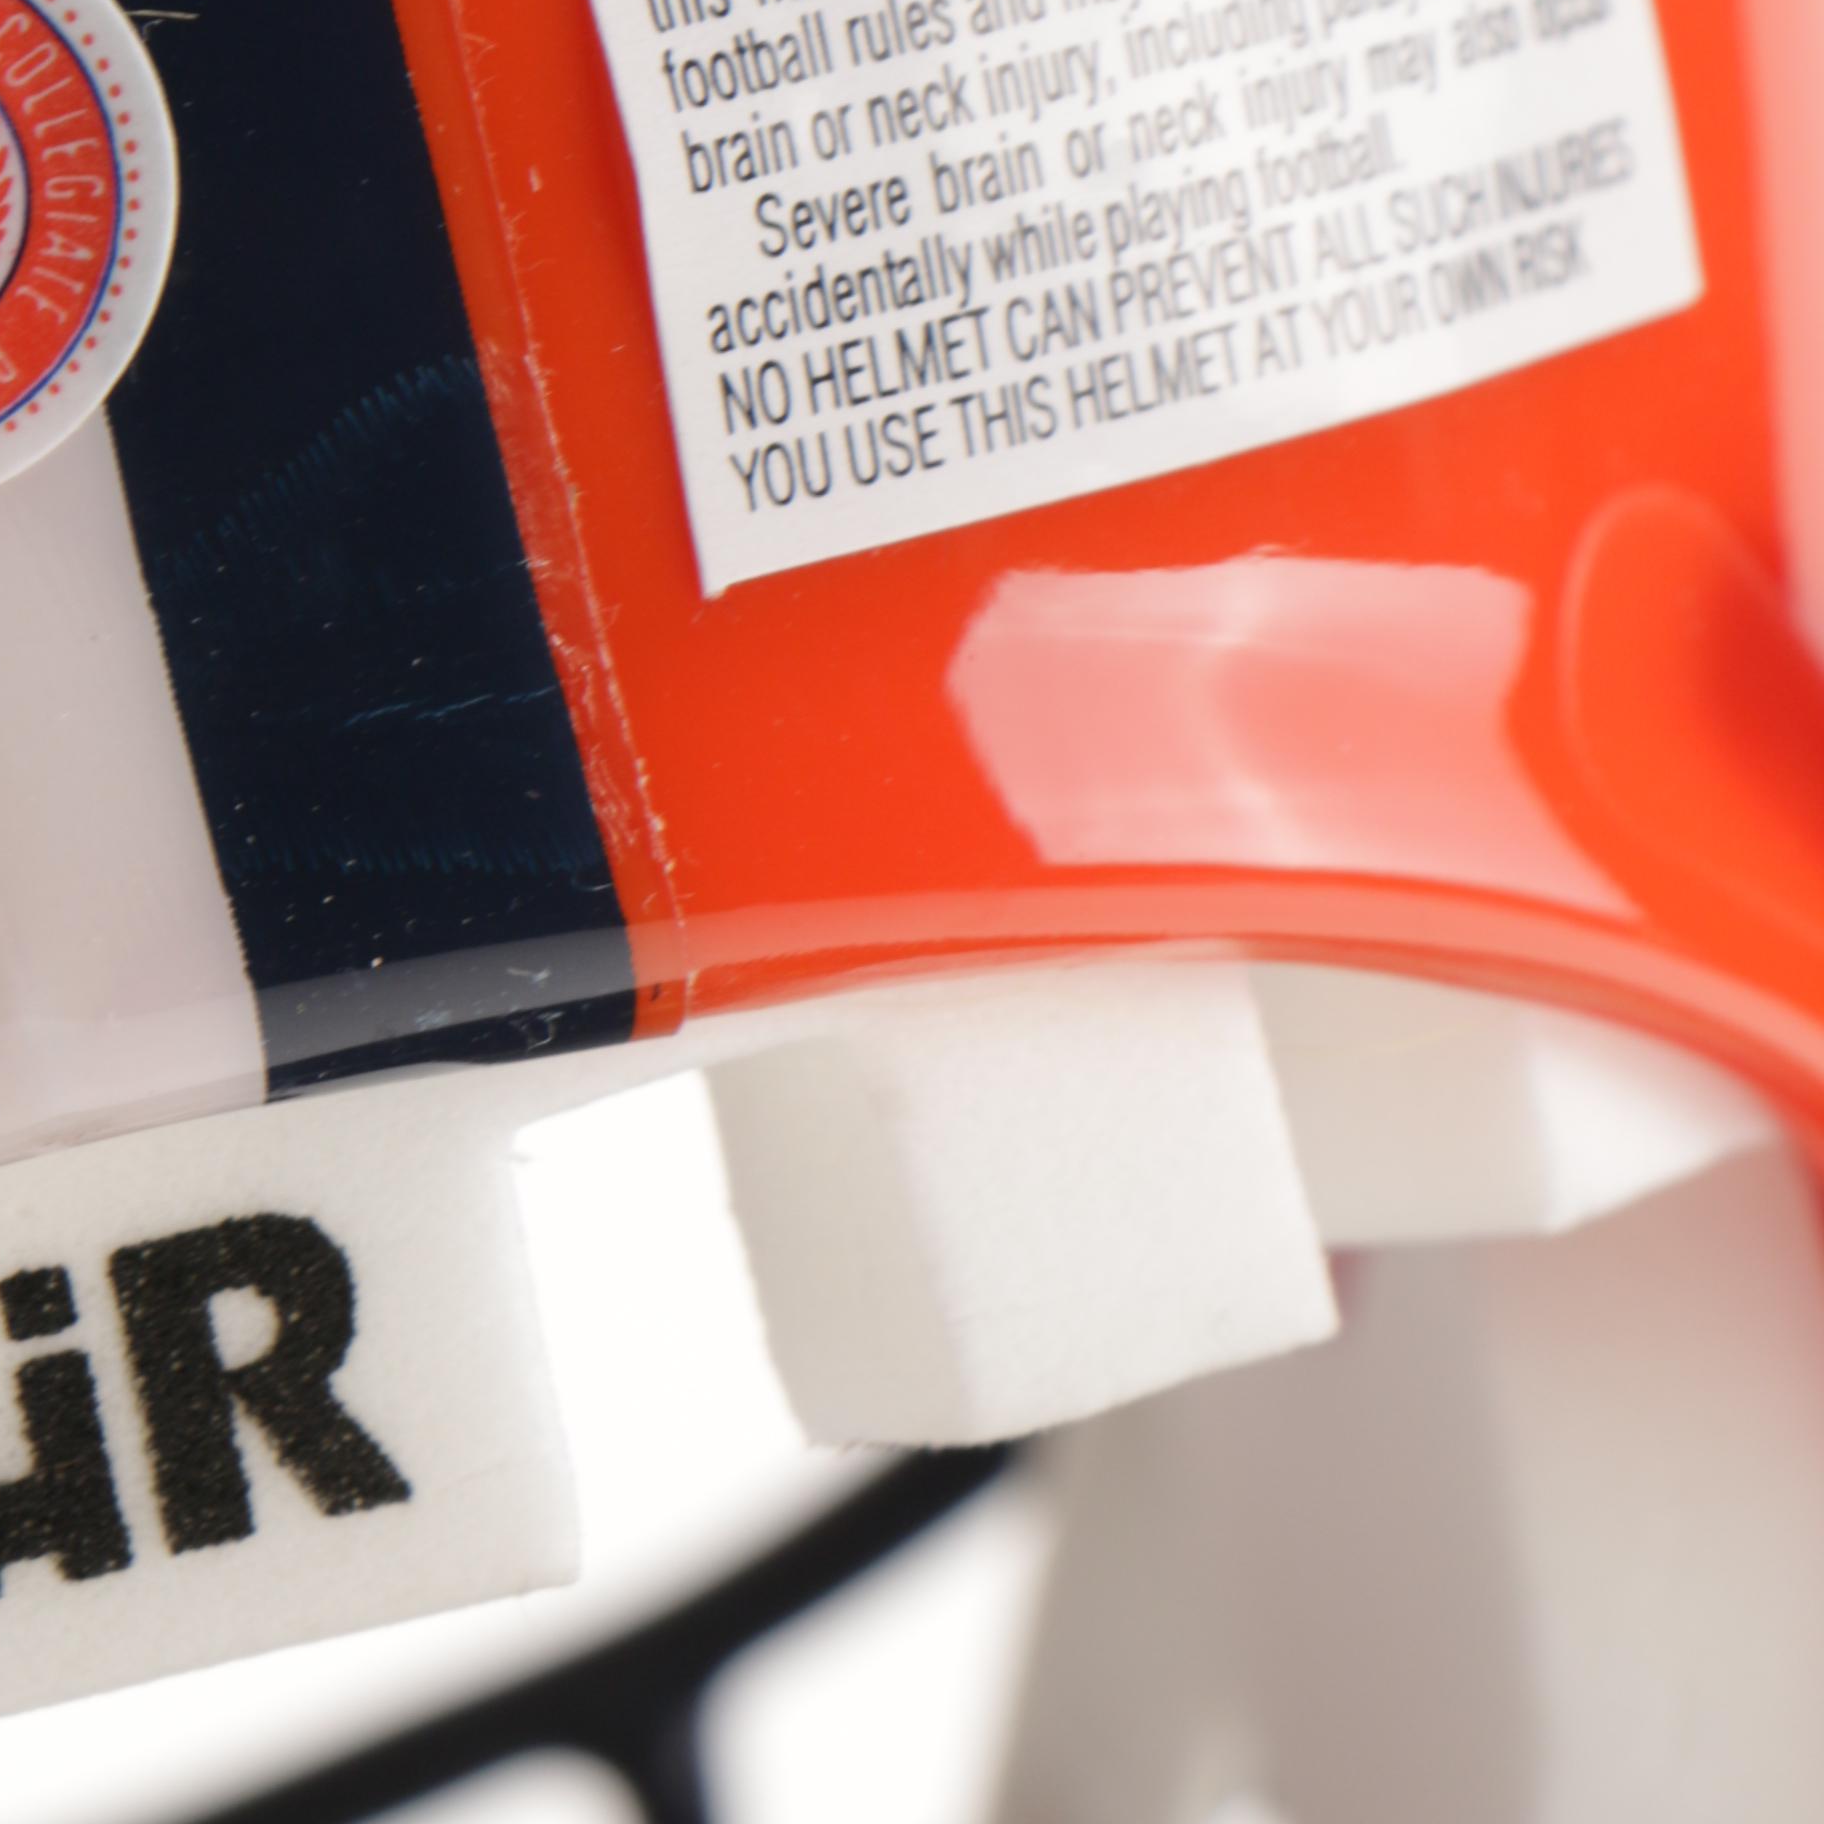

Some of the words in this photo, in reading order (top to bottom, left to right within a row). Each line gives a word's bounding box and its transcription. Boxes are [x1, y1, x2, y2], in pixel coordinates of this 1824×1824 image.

[661, 8, 834, 114] football
[681, 111, 799, 194] brain
[810, 104, 854, 161] or
[866, 62, 975, 148] neck
[979, 41, 1117, 123] injury,
[754, 175, 913, 260] Severe
[928, 133, 1045, 215] brain
[1066, 121, 1107, 179] or
[1127, 80, 1227, 164] neck
[1238, 56, 1348, 135] injury
[1366, 29, 1438, 96] may
[1451, 0, 1520, 68] also
[706, 234, 974, 355] accidentally
[982, 201, 1097, 283] while
[1104, 166, 1251, 265] playing
[718, 359, 793, 436] NO
[804, 306, 991, 416] HELMET
[1005, 278, 1103, 364] CAN
[1108, 222, 1298, 335] PREVENT
[1313, 202, 1388, 279] ALL
[1389, 164, 1494, 256] SUCH
[729, 431, 833, 513] YOU
[844, 403, 946, 487] USE
[949, 375, 1058, 459] THIS
[1064, 321, 1239, 429] HELMET
[1253, 304, 1303, 378] AT
[1311, 271, 1426, 360] YOUR
[1428, 249, 1511, 327] OWN
